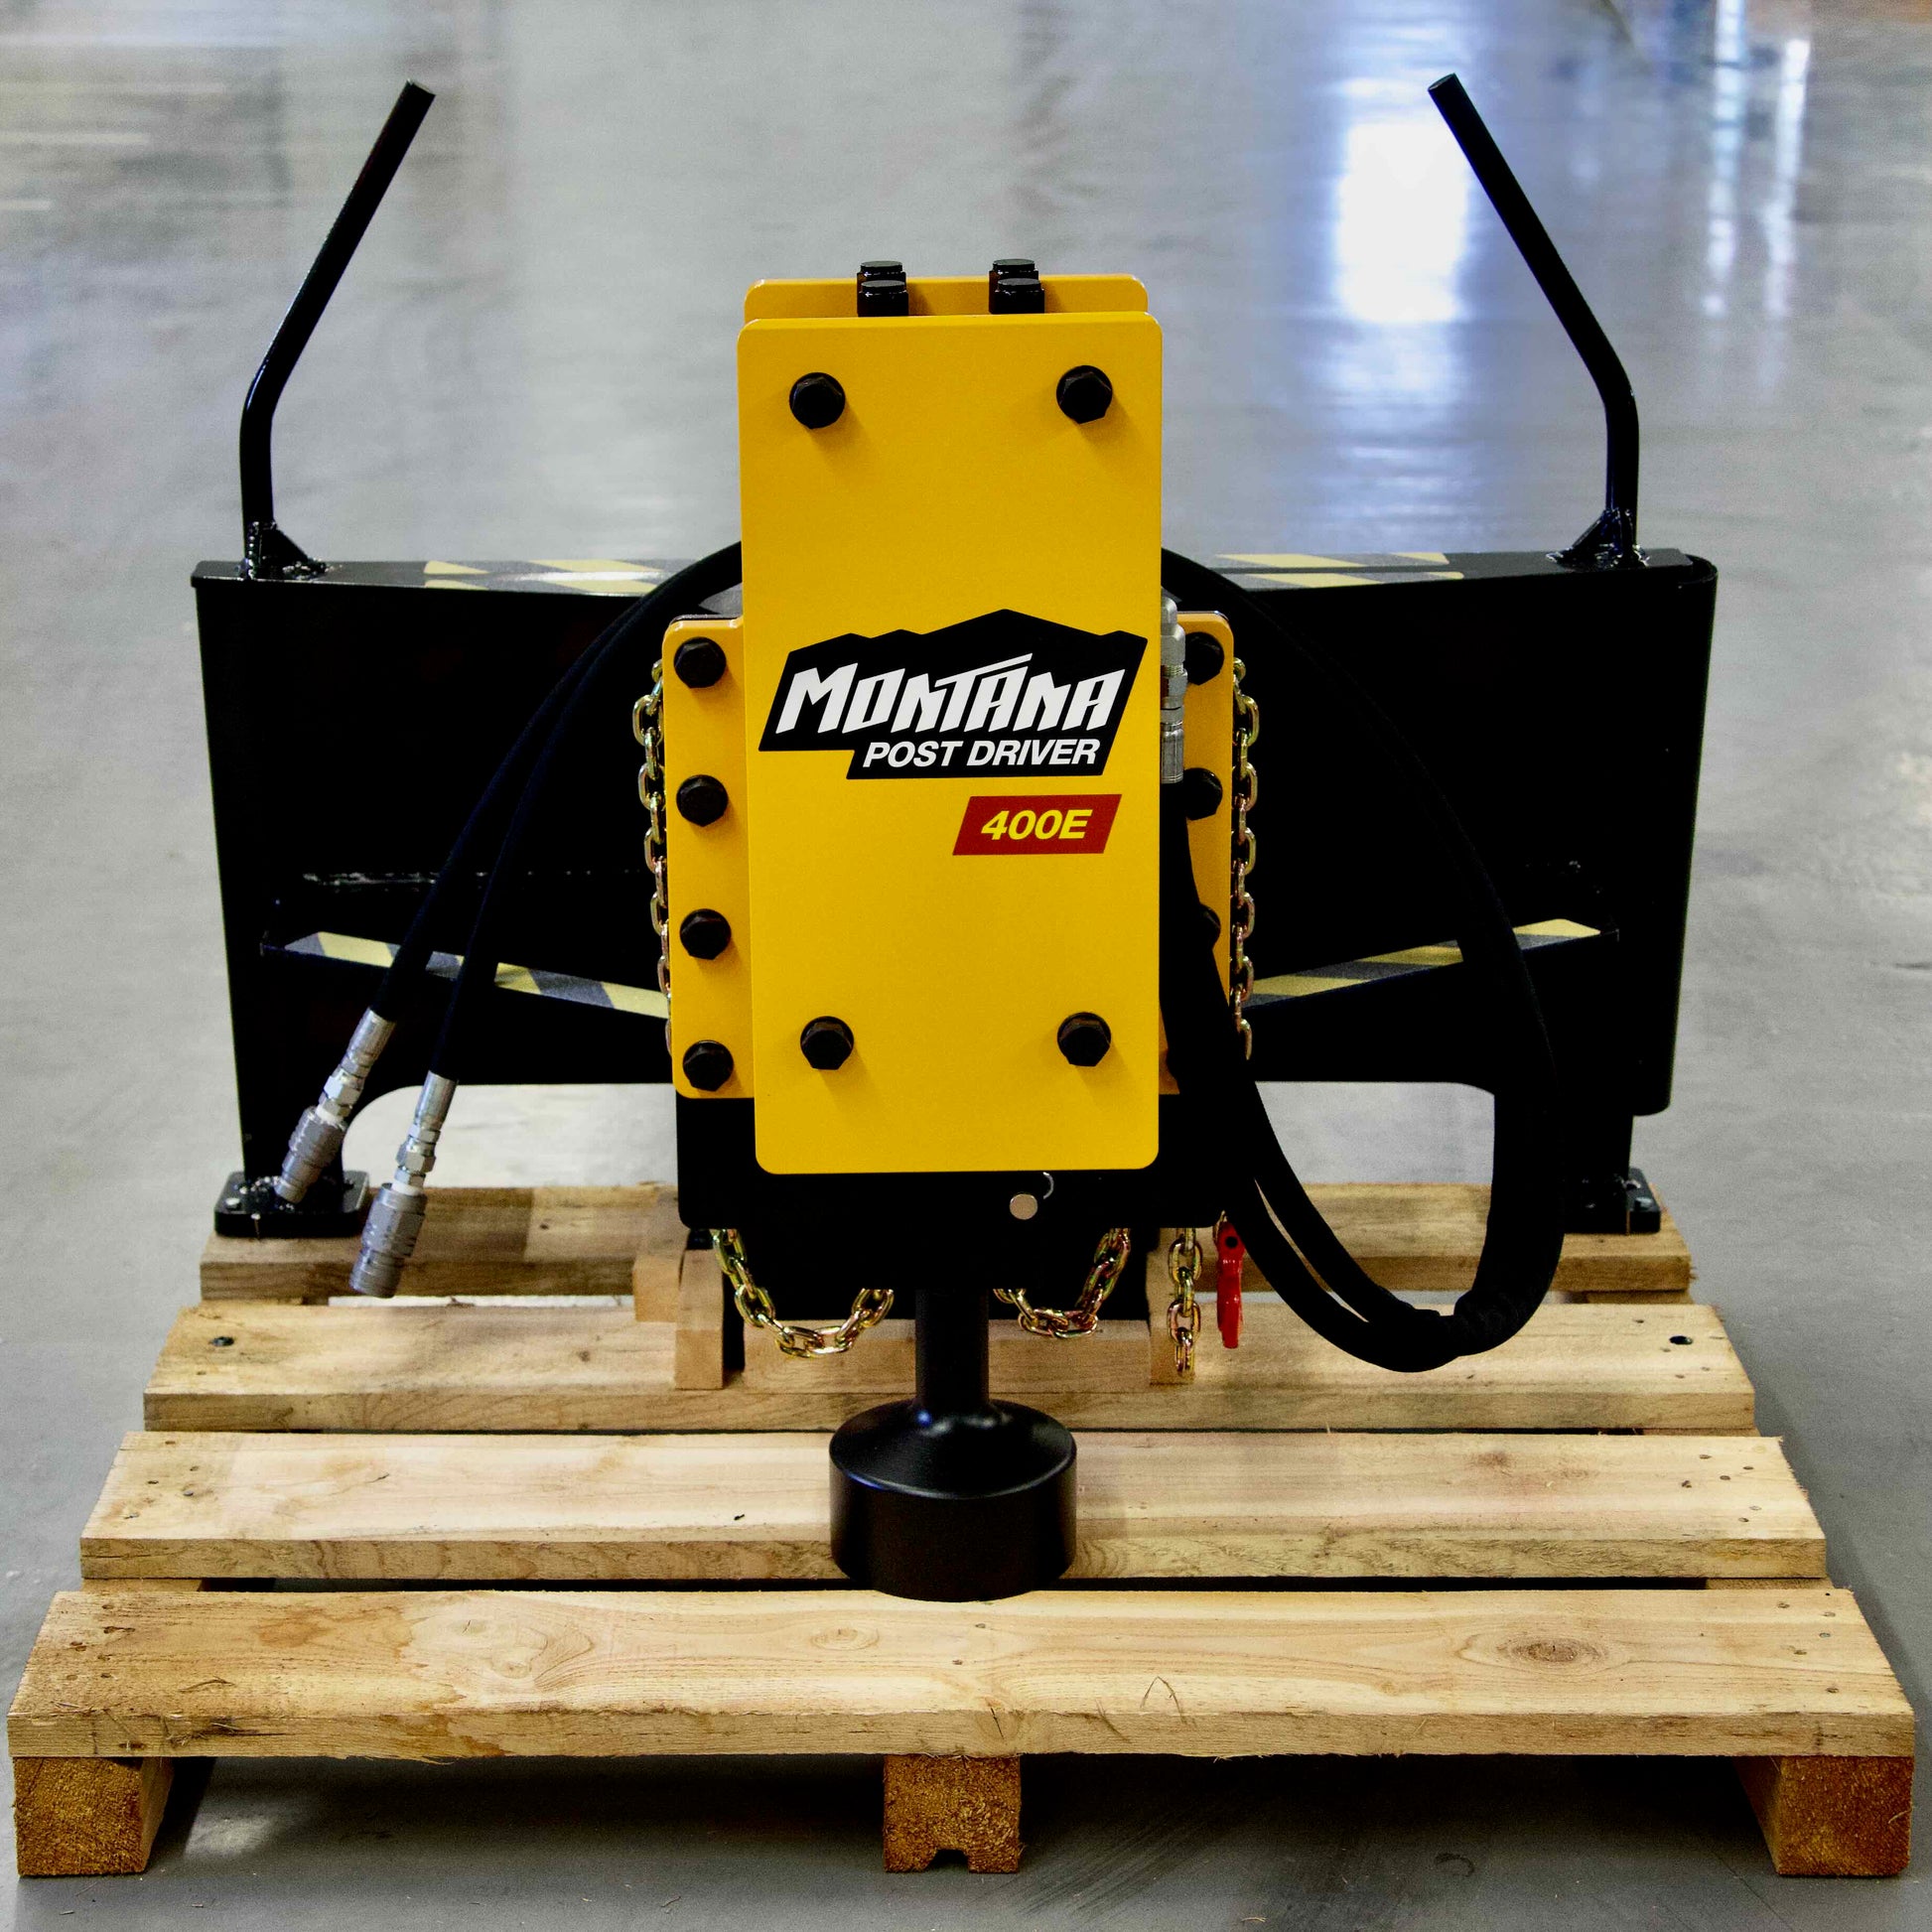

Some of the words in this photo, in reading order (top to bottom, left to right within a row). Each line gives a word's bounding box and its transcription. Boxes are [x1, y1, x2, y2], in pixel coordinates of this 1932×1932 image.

[775, 652, 1126, 735] MONTANA
[862, 740, 964, 768] POST
[966, 738, 1101, 767] DRIVER
[981, 809, 1093, 840] 400E
